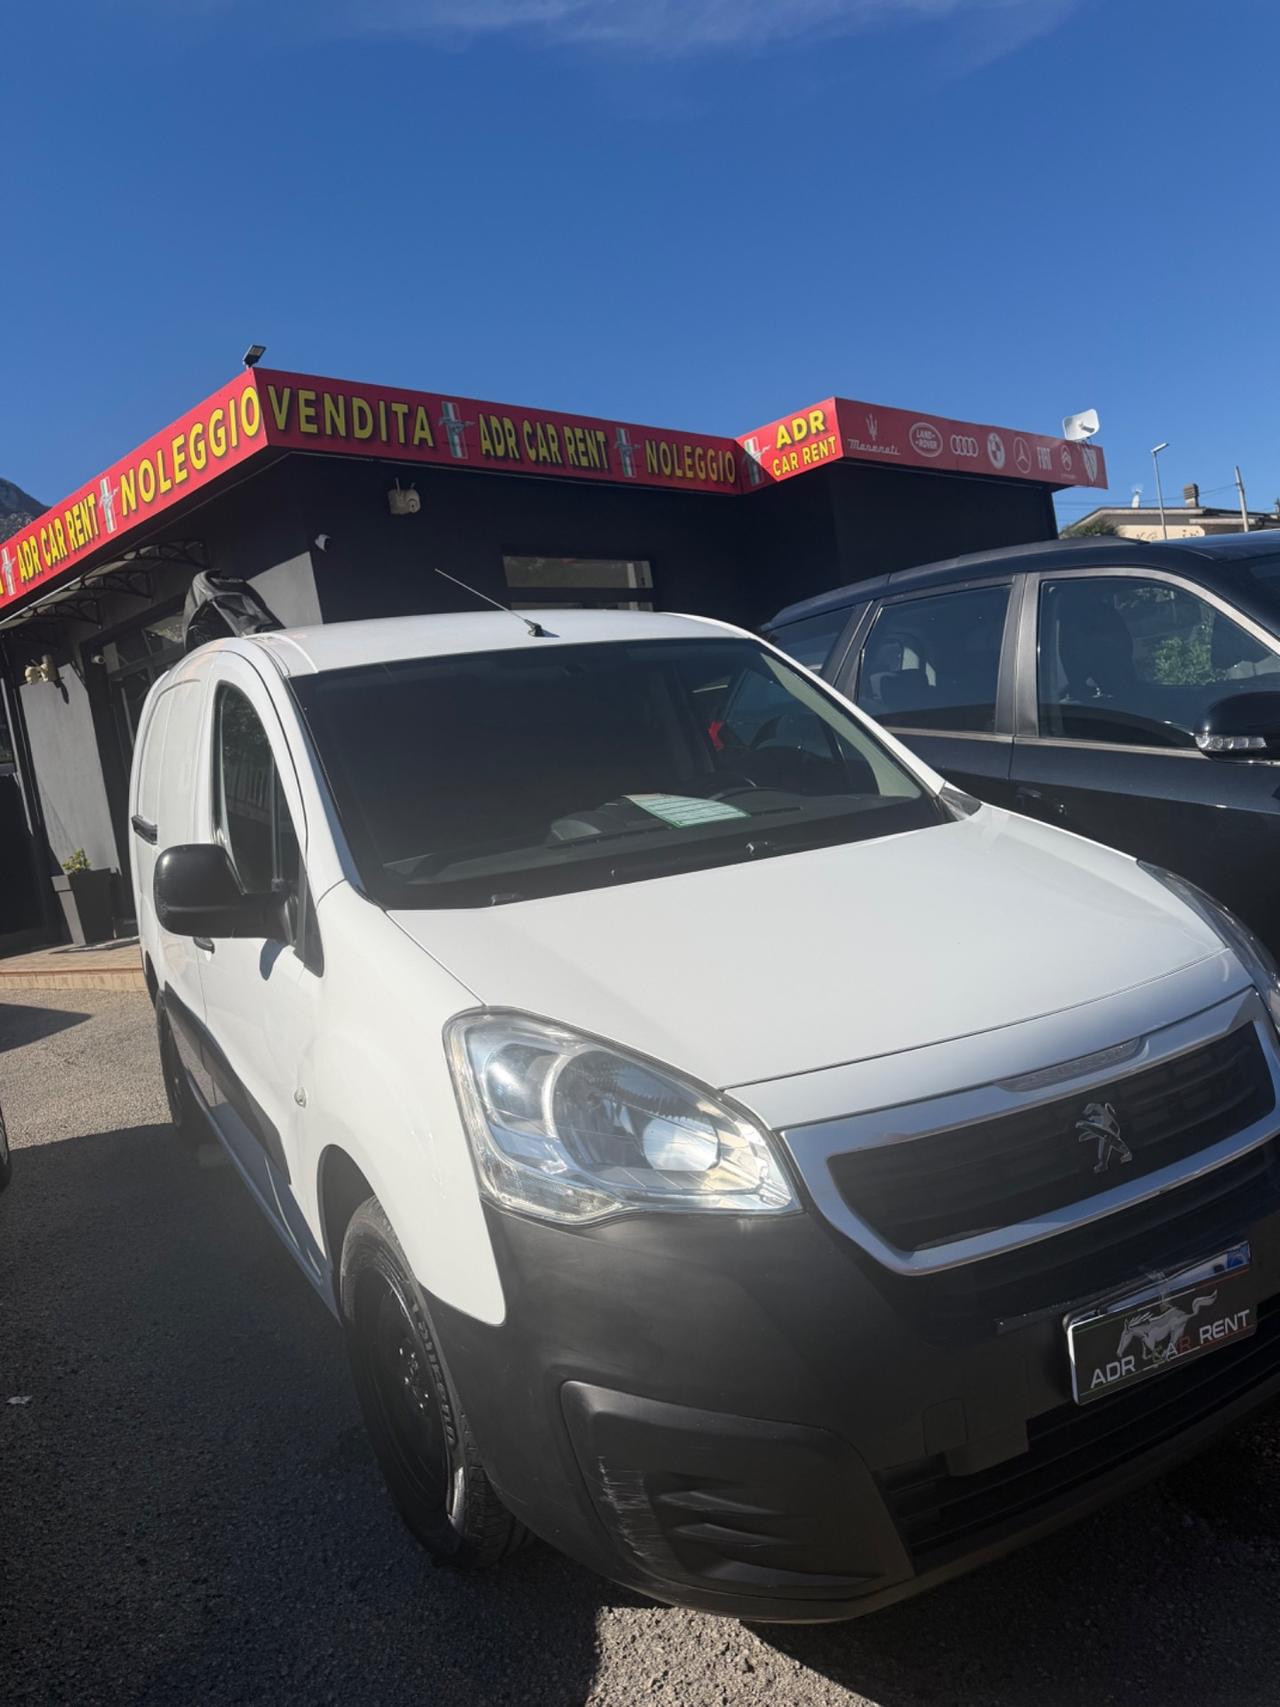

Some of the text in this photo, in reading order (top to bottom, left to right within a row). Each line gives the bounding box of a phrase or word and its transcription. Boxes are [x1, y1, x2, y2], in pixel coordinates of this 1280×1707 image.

[267, 384, 434, 447] VENDITA
[478, 413, 609, 469] ADR CAR RENT
[776, 409, 826, 449] ADR
[120, 386, 261, 517] NOLEGGIO
[645, 439, 736, 484] NOLEGGIO
[772, 435, 837, 477] CAR RENT
[16, 538, 42, 583] ADR
[40, 517, 68, 567] CAR
[64, 492, 99, 550] RENT
[1090, 1355, 1136, 1389] ADR
[1199, 1309, 1250, 1345] RENT
